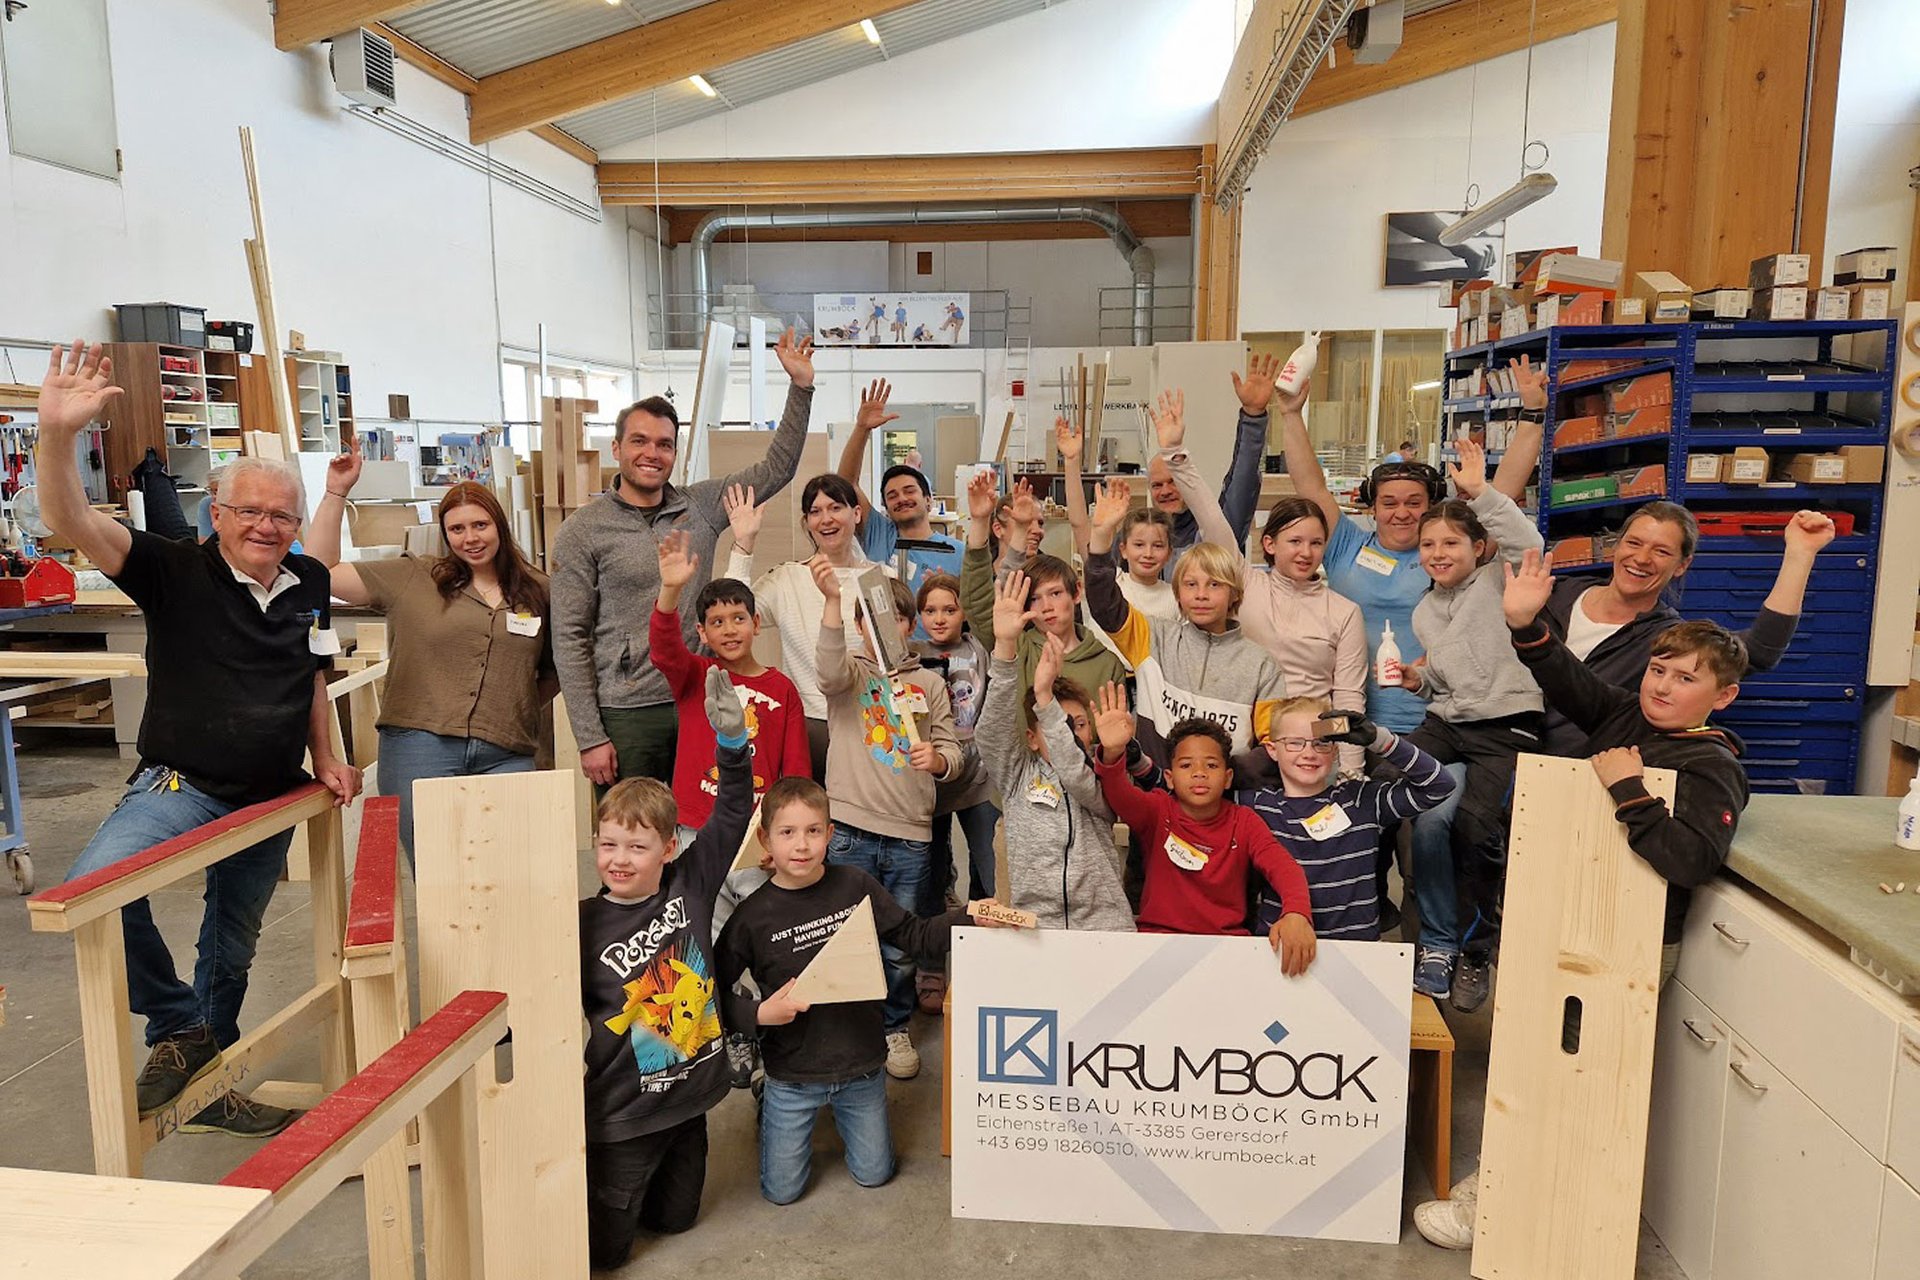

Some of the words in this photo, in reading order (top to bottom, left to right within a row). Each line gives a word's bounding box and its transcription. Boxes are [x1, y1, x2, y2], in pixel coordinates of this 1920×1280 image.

[1162, 690, 1196, 720] SINCE
[771, 928, 793, 943] JUST
[793, 914, 835, 934] THINKING
[794, 927, 827, 944] HAVING
[977, 1092, 1120, 1115] MESSEBAU
[1133, 1101, 1288, 1124] KRUMBÖCK
[1301, 1109, 1379, 1129] GmbH
[976, 1114, 1088, 1134] Eichenstraße
[1093, 1121, 1103, 1135] 1,
[1109, 1122, 1186, 1139] AT-3385
[1191, 1126, 1289, 1144] Gerersdorf
[976, 1135, 1009, 1150] +43
[1015, 1137, 1048, 1151] 699
[1055, 1138, 1138, 1158] 18260510,
[1144, 1147, 1317, 1167] www.krumboeck.at
